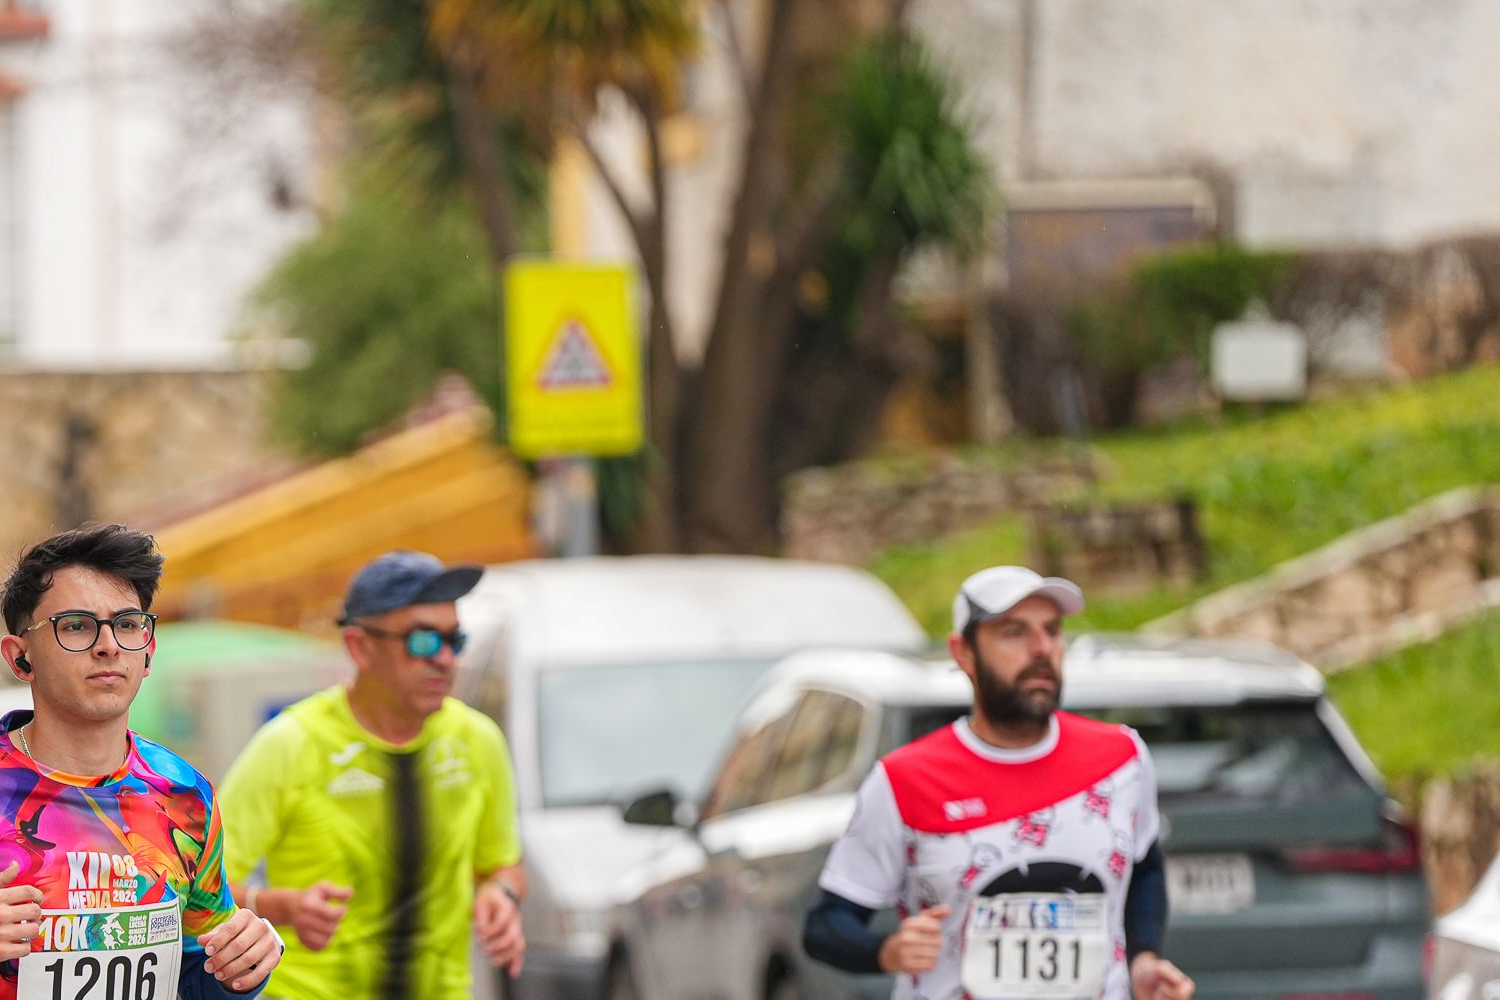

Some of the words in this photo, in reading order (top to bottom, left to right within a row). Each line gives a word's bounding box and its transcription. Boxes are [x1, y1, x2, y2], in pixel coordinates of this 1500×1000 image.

[112, 854, 139, 877] 08
[112, 878, 139, 889] MARZO
[68, 890, 111, 909] MEDIA
[112, 889, 138, 904] 2026
[39, 914, 90, 951] 10K
[128, 933, 146, 946] 2026
[987, 937, 1082, 981] 1131
